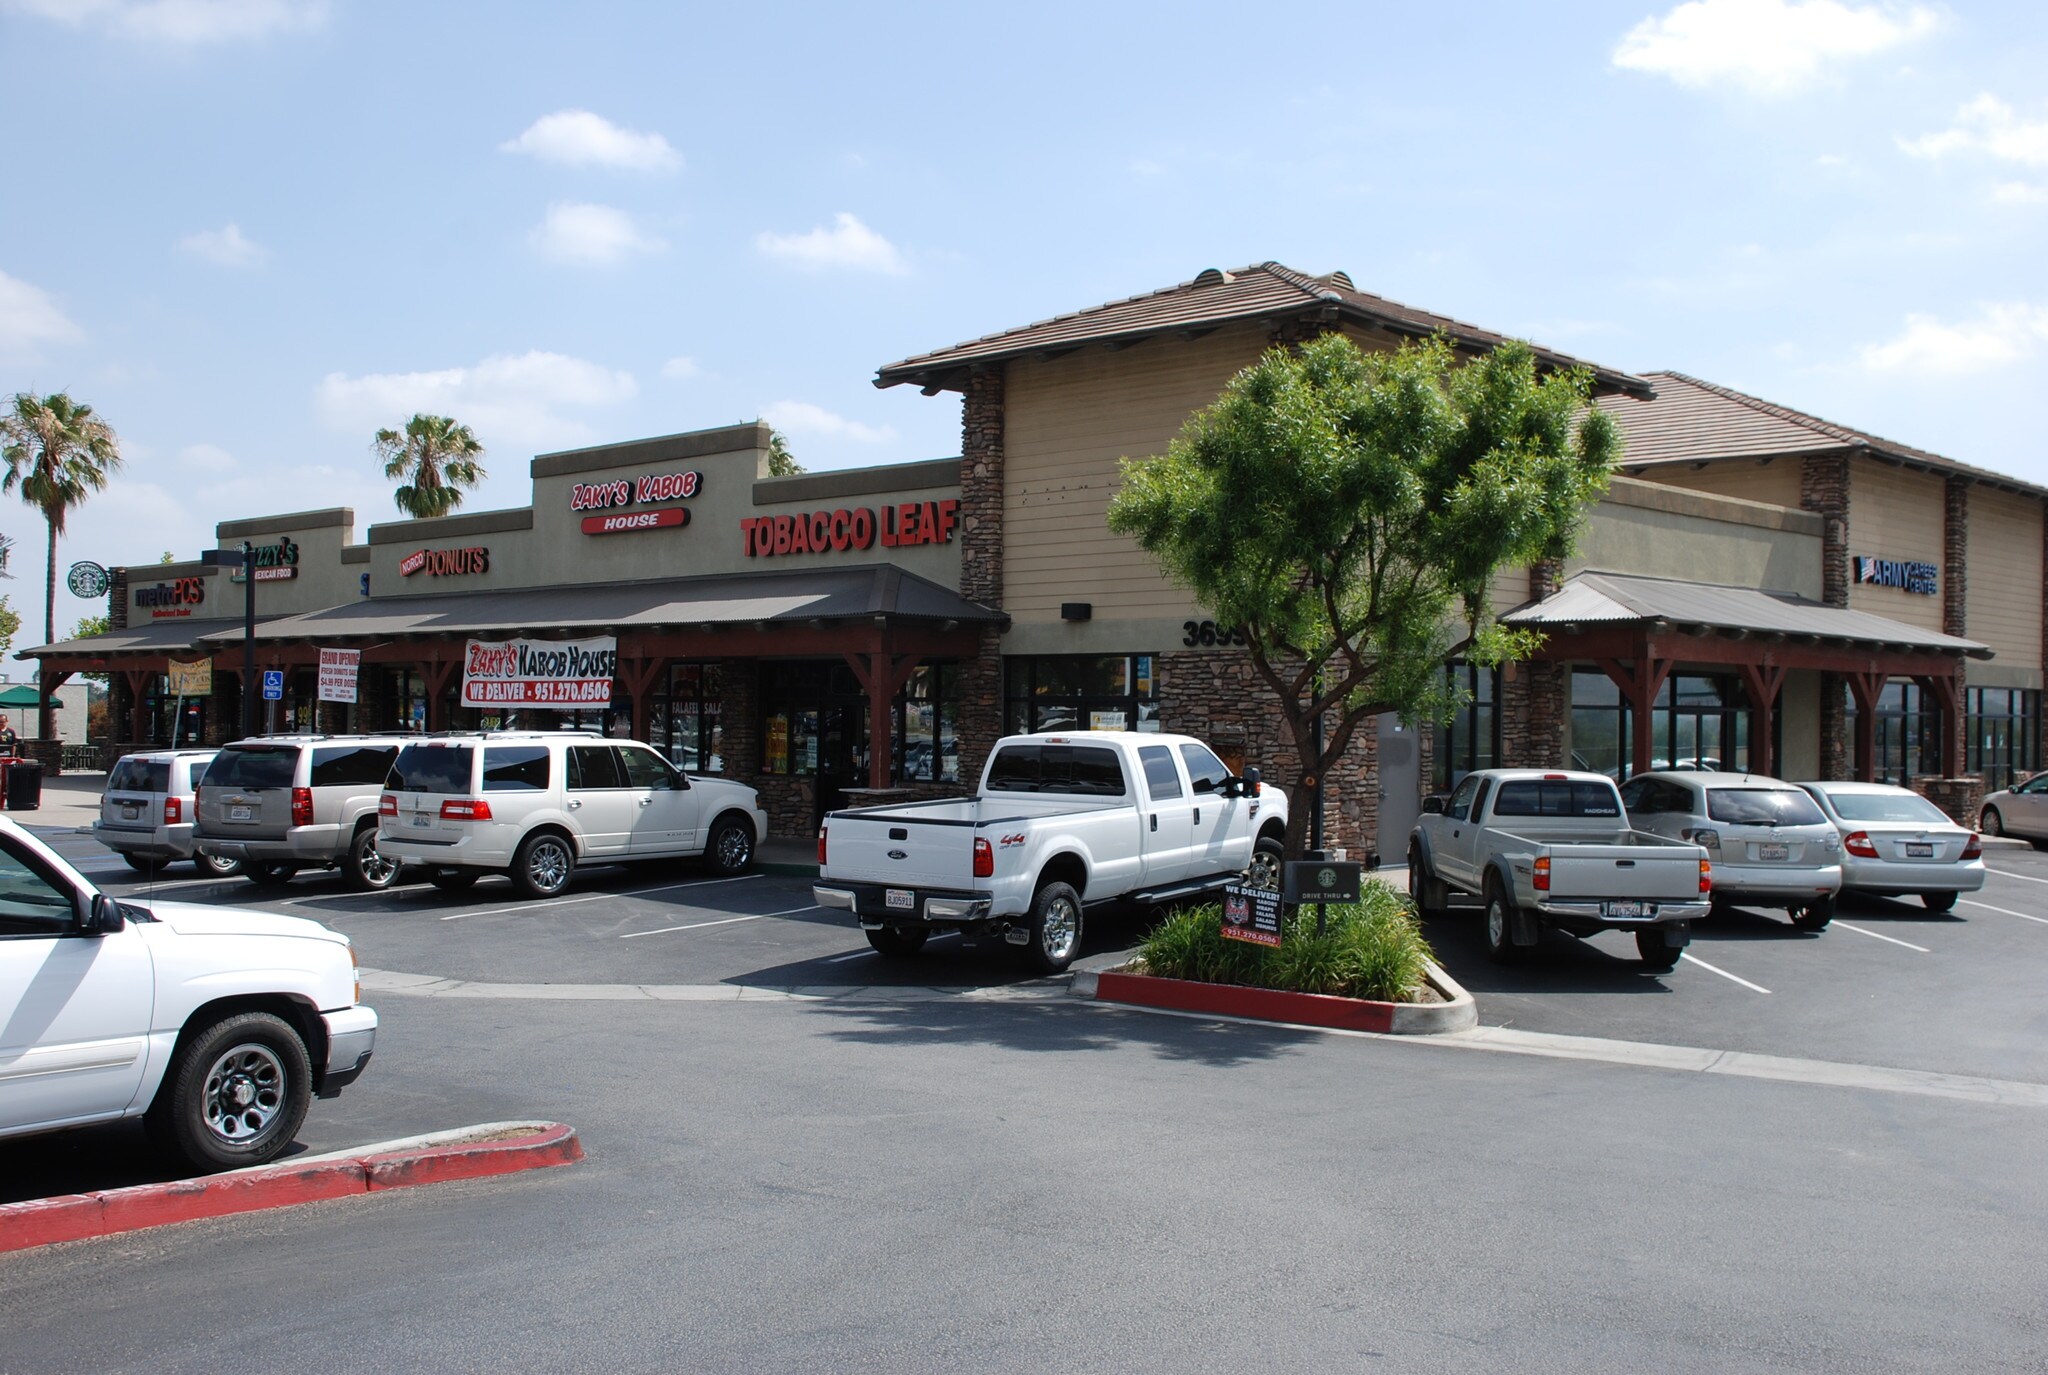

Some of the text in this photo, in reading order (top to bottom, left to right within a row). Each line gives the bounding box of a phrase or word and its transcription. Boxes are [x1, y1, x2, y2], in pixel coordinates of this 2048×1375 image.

[571, 471, 697, 511] ZAKY'S KABOB
[604, 513, 659, 530] HOUSE
[741, 499, 958, 557] TOBACCO LEAF
[402, 546, 485, 577] NORCO DONUTS
[71, 566, 104, 581] STARBUCKS
[277, 568, 292, 579] FOOD
[1873, 560, 1910, 588] ARMY
[76, 588, 100, 598] COFFEE
[135, 576, 203, 607] metroPCS
[467, 641, 616, 678] ZAKY'S KABOB HOUSE
[470, 683, 484, 700] WE
[486, 682, 525, 700] DELIVER
[535, 681, 610, 700] 951.270.0506
[1225, 885, 1280, 901] WE DELIVER!
[1255, 911, 1277, 919] FALAFEL
[1255, 916, 1276, 925] SALADS
[1227, 928, 1277, 944] 951.270.0506
